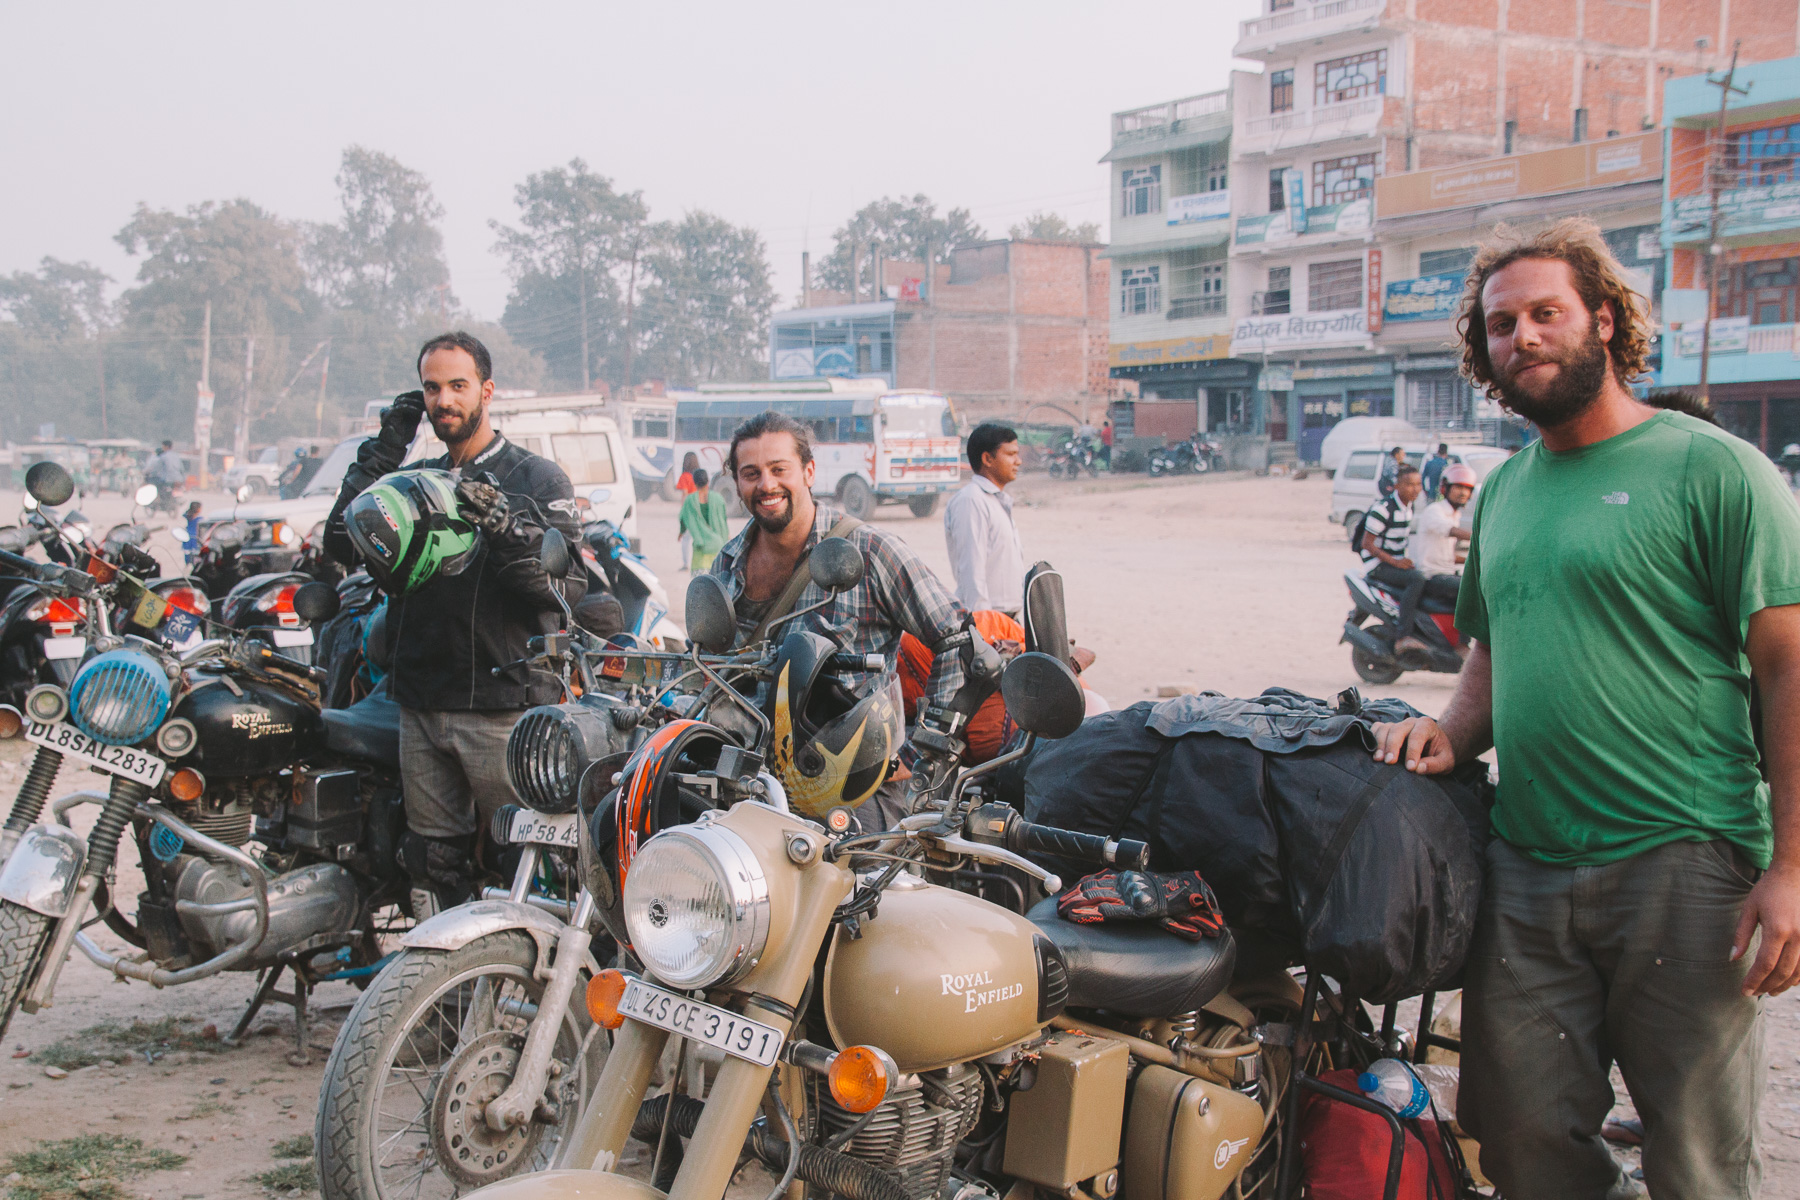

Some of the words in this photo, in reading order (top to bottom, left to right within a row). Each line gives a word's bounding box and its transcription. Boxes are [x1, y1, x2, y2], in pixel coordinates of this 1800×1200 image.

[231, 713, 271, 730] ROYAL
[516, 823, 533, 841] HP
[535, 824, 557, 842] 58
[940, 970, 993, 996] ROYAL
[964, 982, 1023, 1013] ENFIELD
